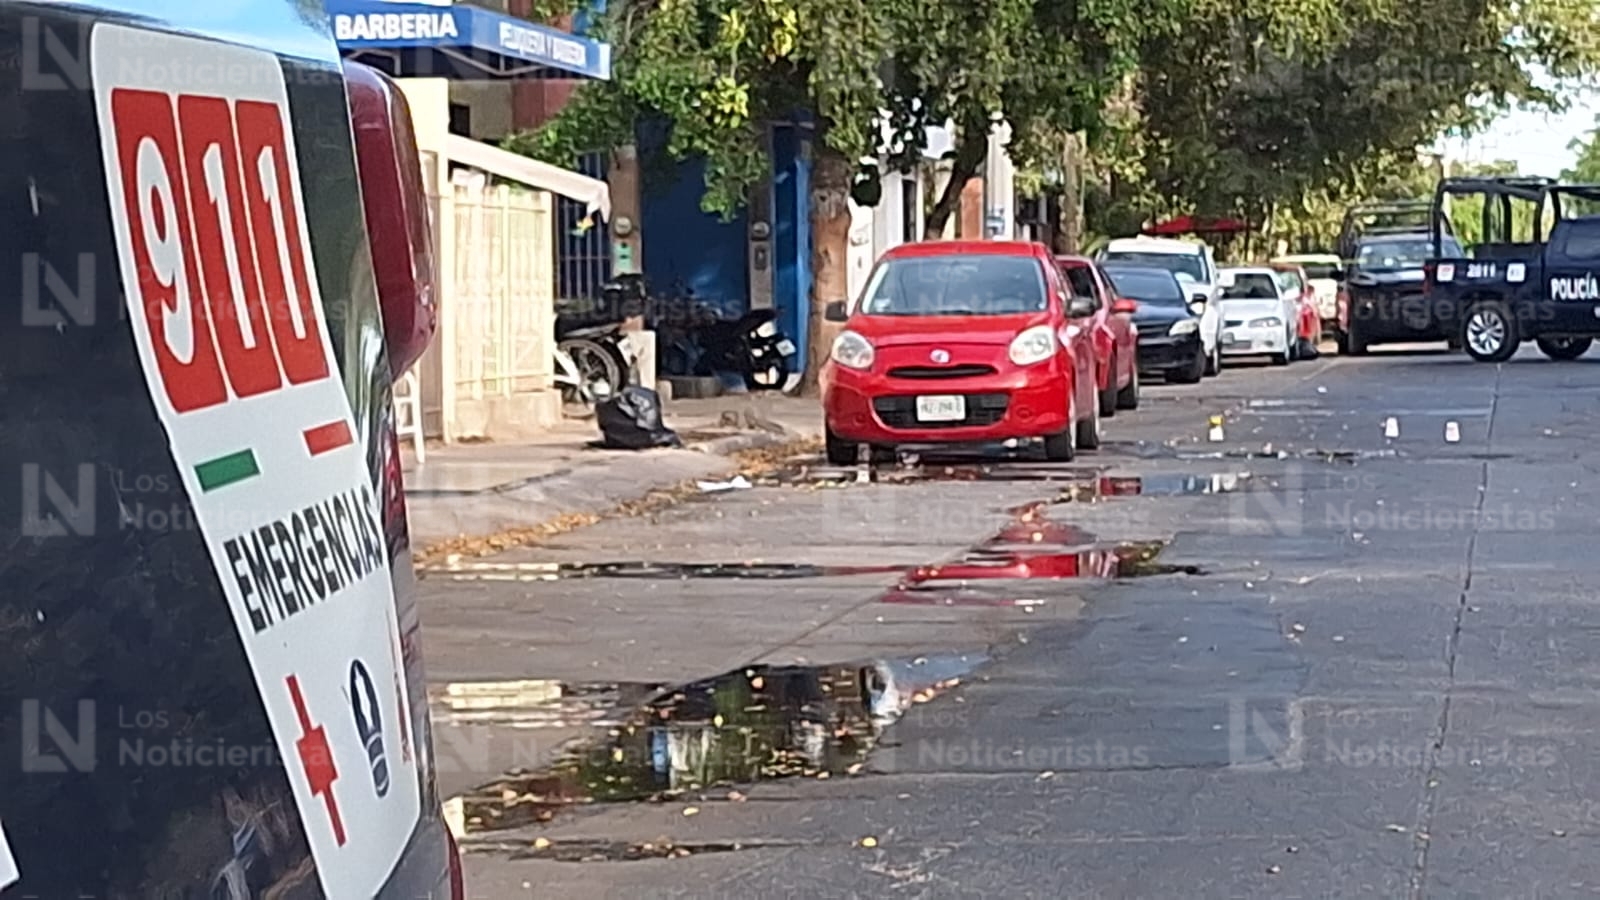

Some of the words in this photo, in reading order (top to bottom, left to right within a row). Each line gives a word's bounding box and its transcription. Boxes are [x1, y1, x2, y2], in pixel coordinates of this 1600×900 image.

[335, 14, 457, 40] BARBERIA
[137, 136, 306, 366] 911
[1551, 272, 1599, 300] POLICÍA
[223, 485, 384, 634] EMERGENCIAS
